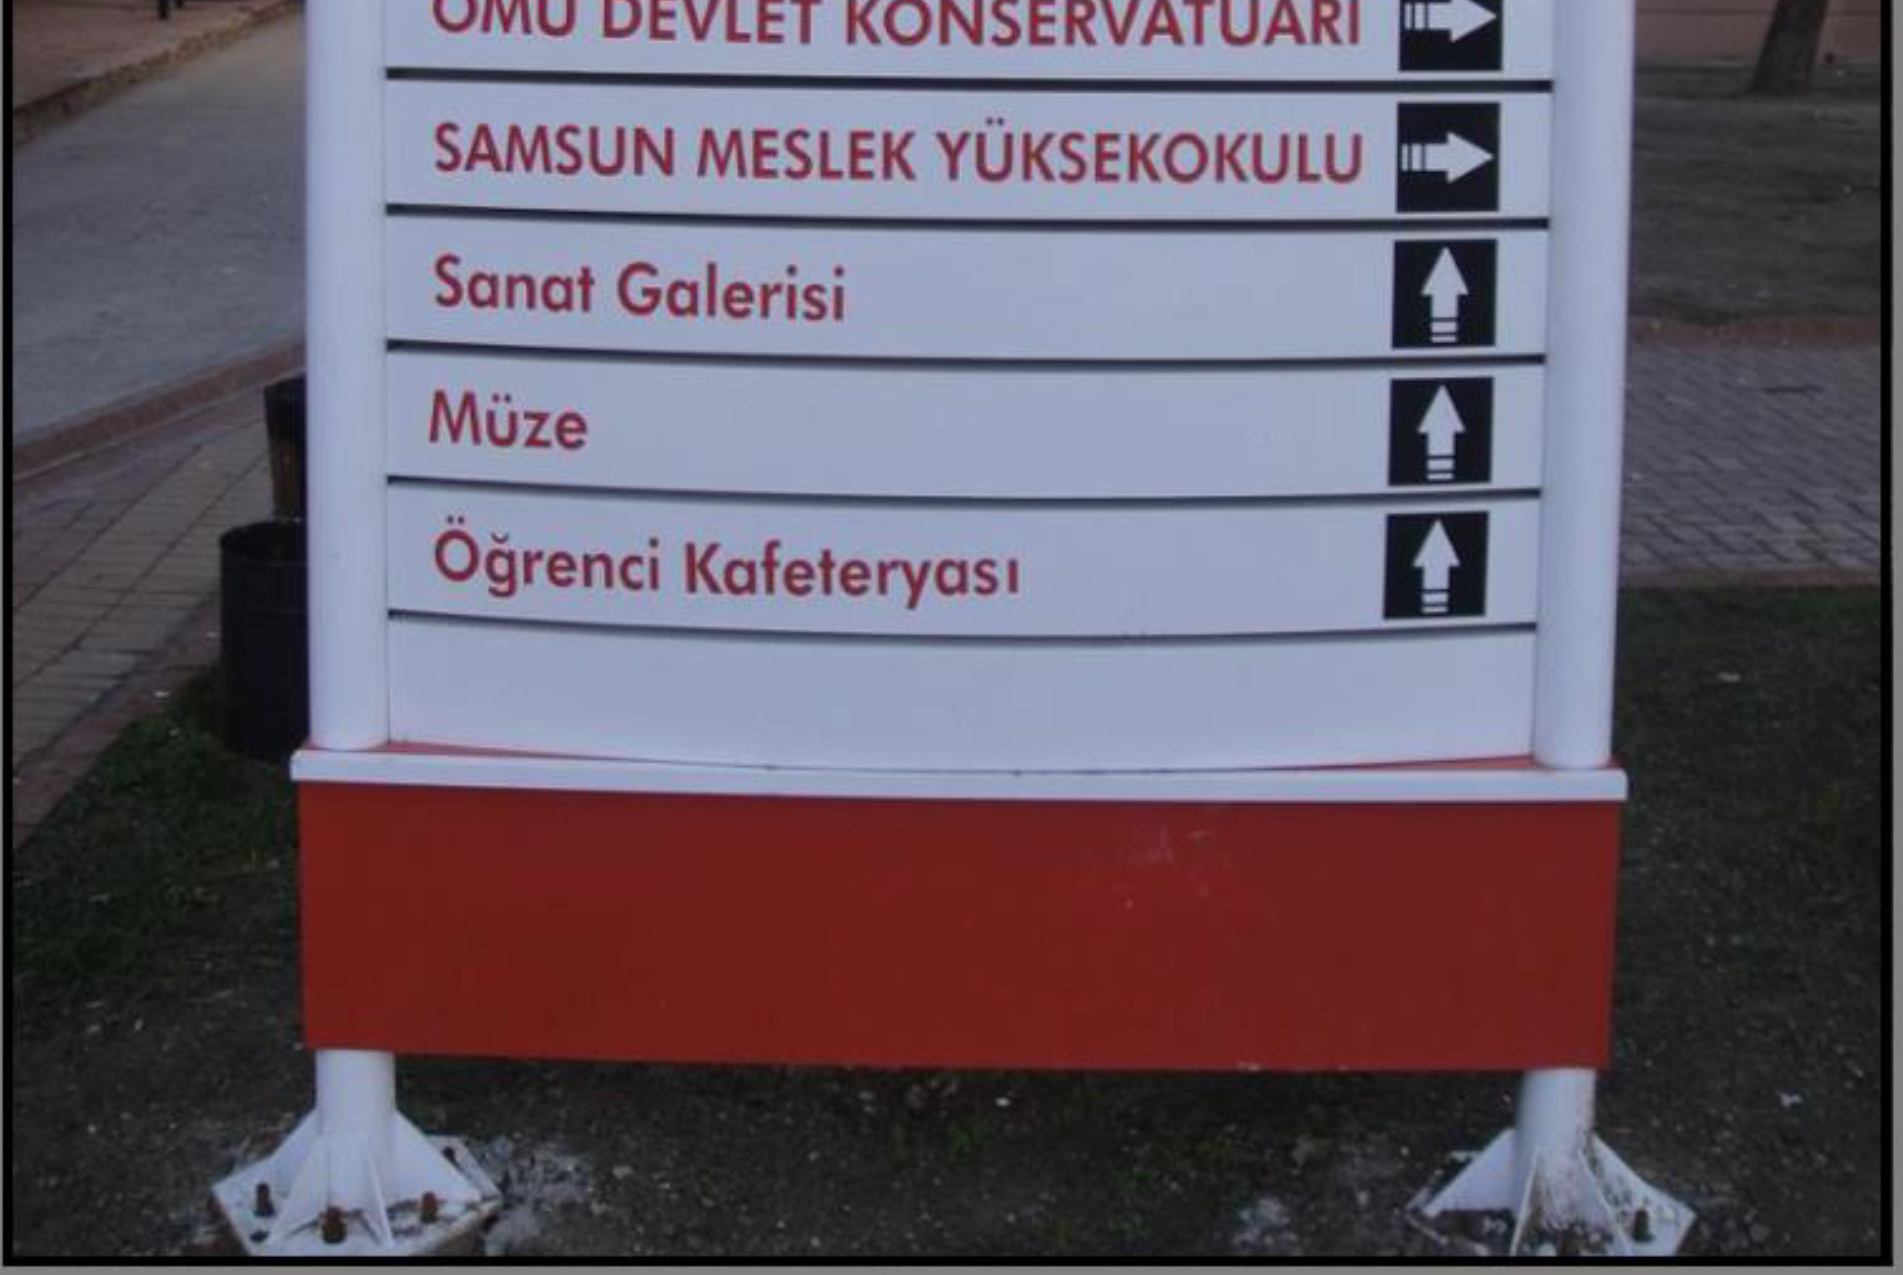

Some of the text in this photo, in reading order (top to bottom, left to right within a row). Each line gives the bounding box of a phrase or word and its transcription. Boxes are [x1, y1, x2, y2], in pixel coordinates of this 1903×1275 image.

[434, 117, 1363, 184] SAMSUN MESLEK YÜKSEKOKULU
[434, 253, 846, 321] Sanat Galerisi
[428, 390, 588, 450] Müze
[434, 515, 1019, 609] Öğrenci Kafeteryası
